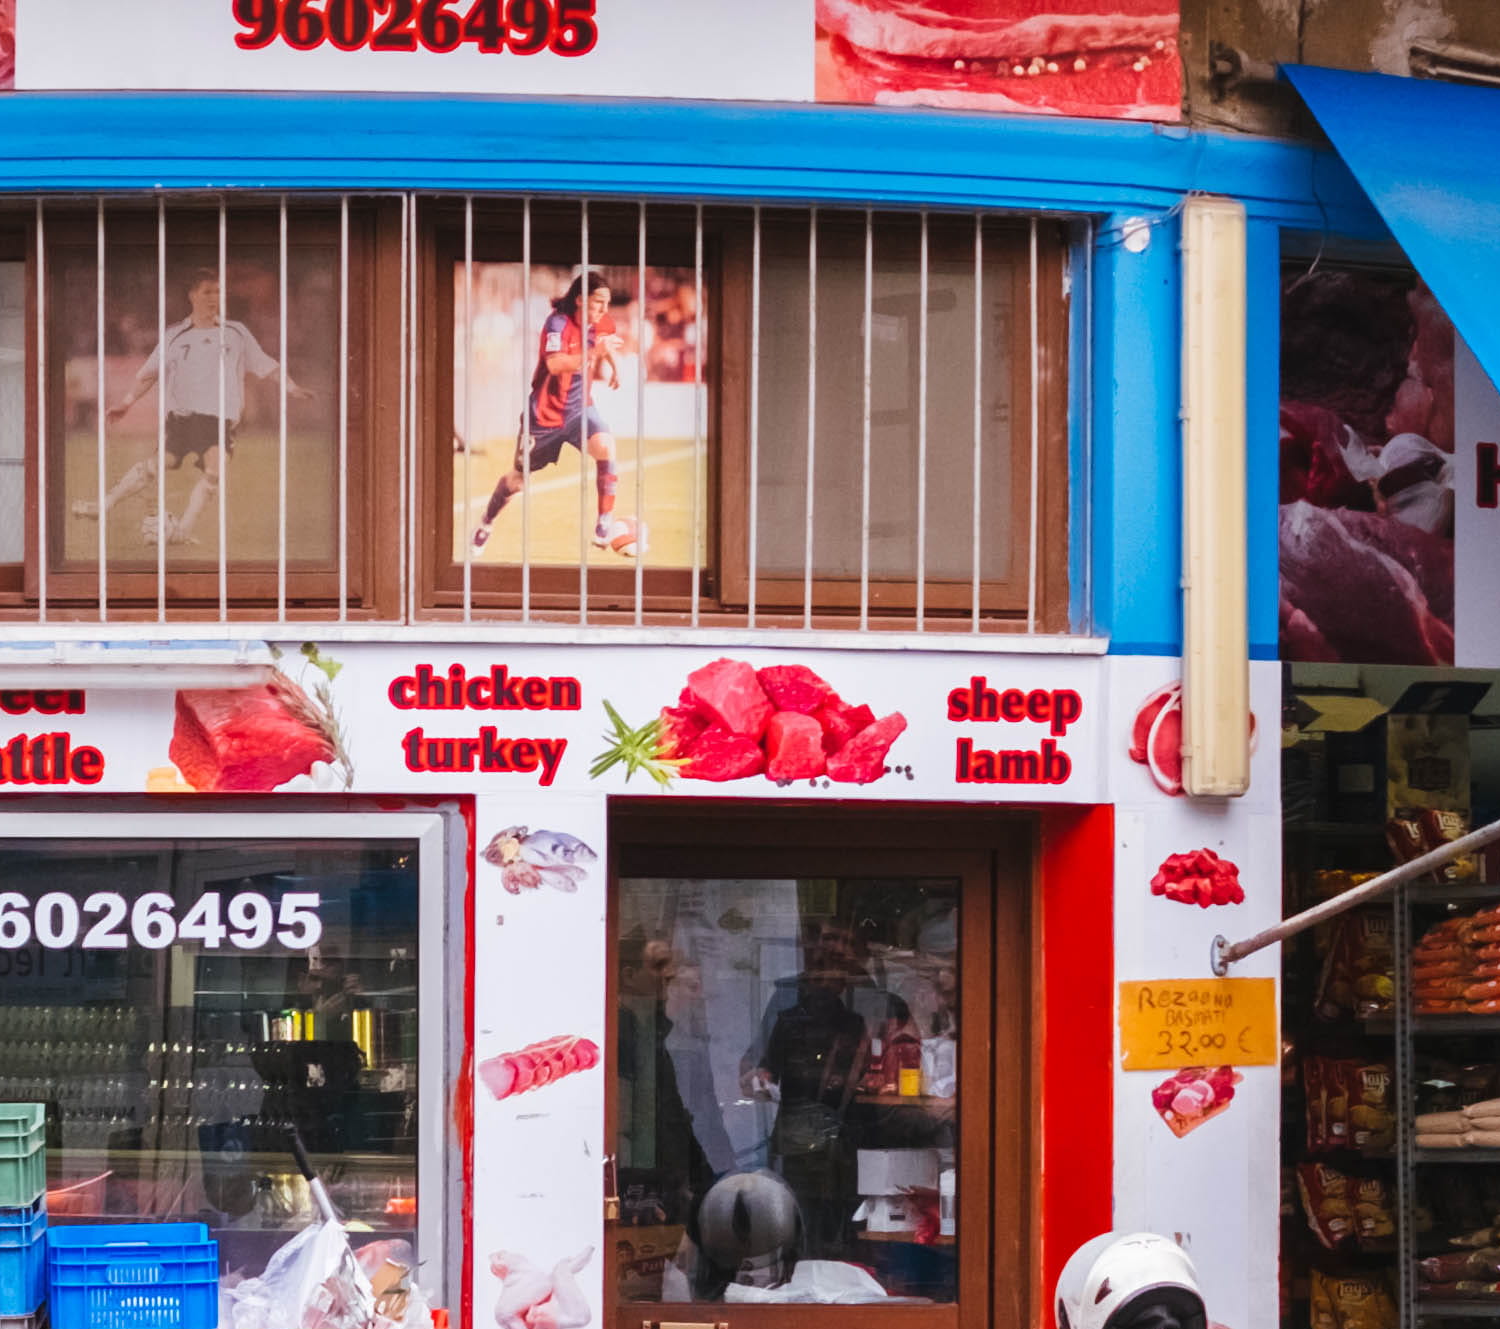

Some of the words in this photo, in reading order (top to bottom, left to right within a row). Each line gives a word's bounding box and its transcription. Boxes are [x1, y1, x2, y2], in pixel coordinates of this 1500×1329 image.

[388, 663, 582, 711] chicken
[947, 675, 1083, 737] sheep
[401, 726, 568, 787] turkey
[956, 737, 1073, 785] lamb
